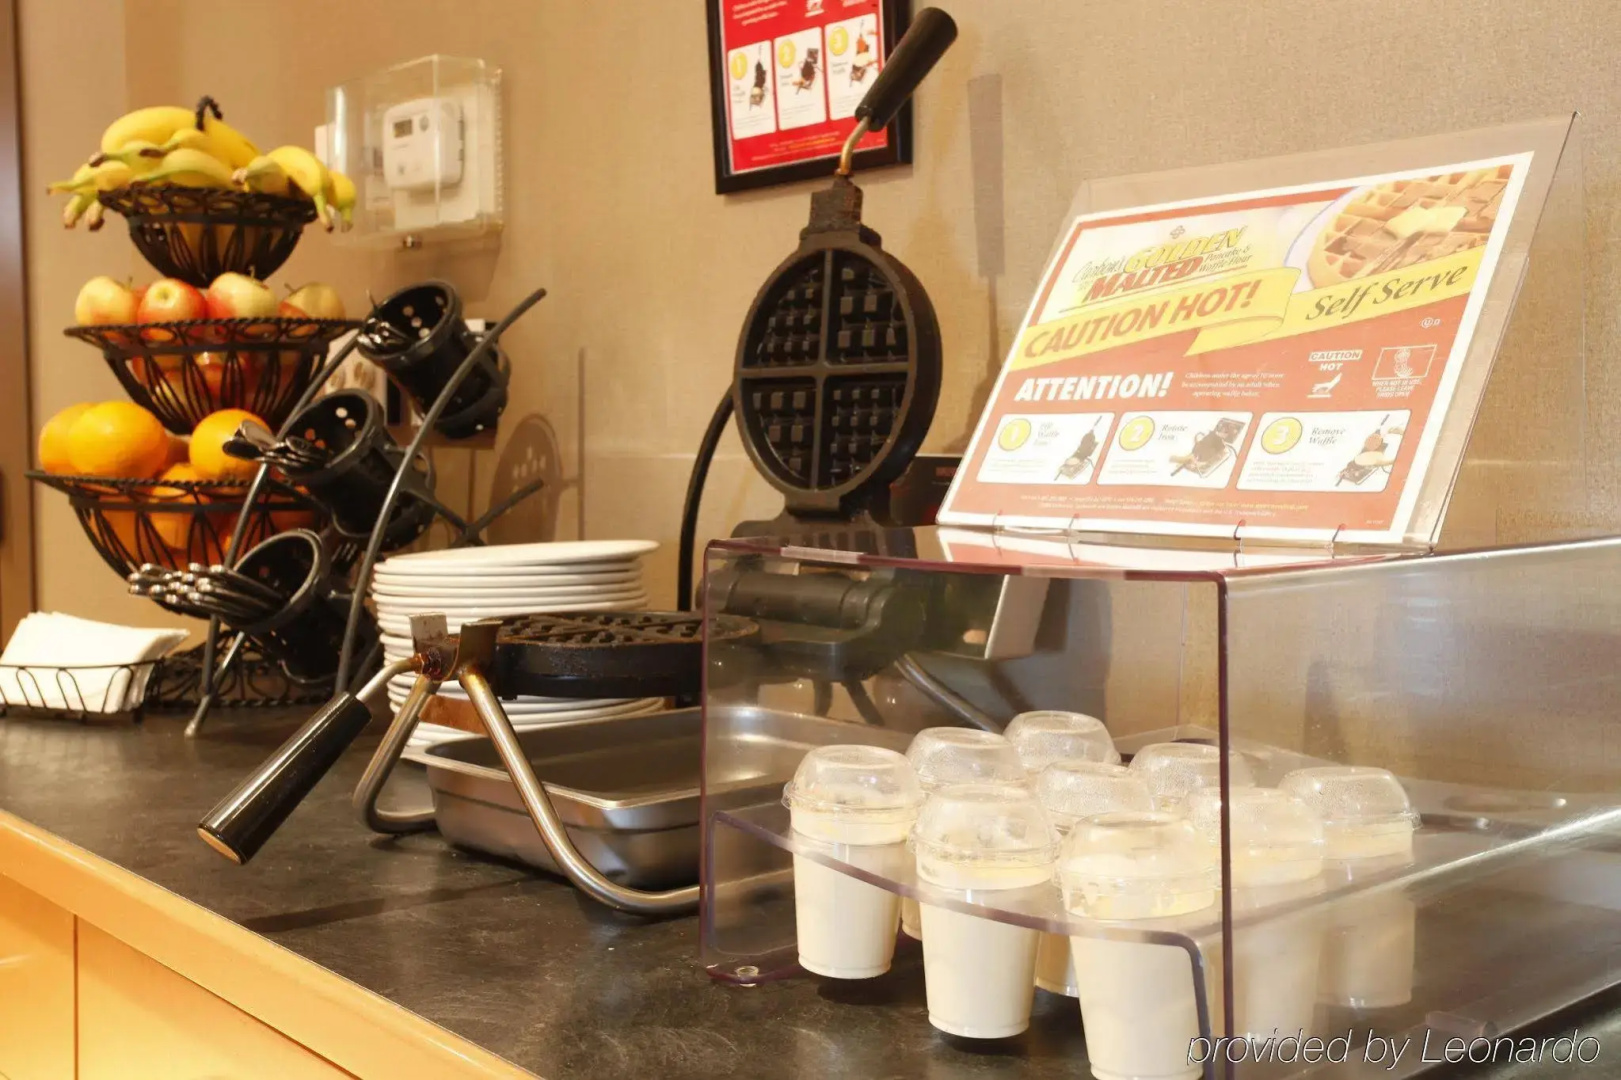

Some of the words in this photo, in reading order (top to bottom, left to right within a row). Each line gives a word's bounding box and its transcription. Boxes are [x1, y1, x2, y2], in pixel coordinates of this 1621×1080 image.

[1122, 226, 1249, 274] GOLDEN
[1082, 256, 1204, 303] MALTED
[1305, 281, 1380, 320] Self
[1372, 265, 1468, 305] Serve
[1024, 300, 1170, 358] CAUTION
[1168, 279, 1263, 325] HOT!
[1310, 350, 1361, 361] CAUTION
[1319, 363, 1344, 372] HOT
[1014, 371, 1175, 402] ATTENTION!
[1010, 427, 1020, 443] 1
[1130, 425, 1145, 442] 2
[1273, 427, 1289, 445] 3
[1310, 427, 1347, 436] Remove
